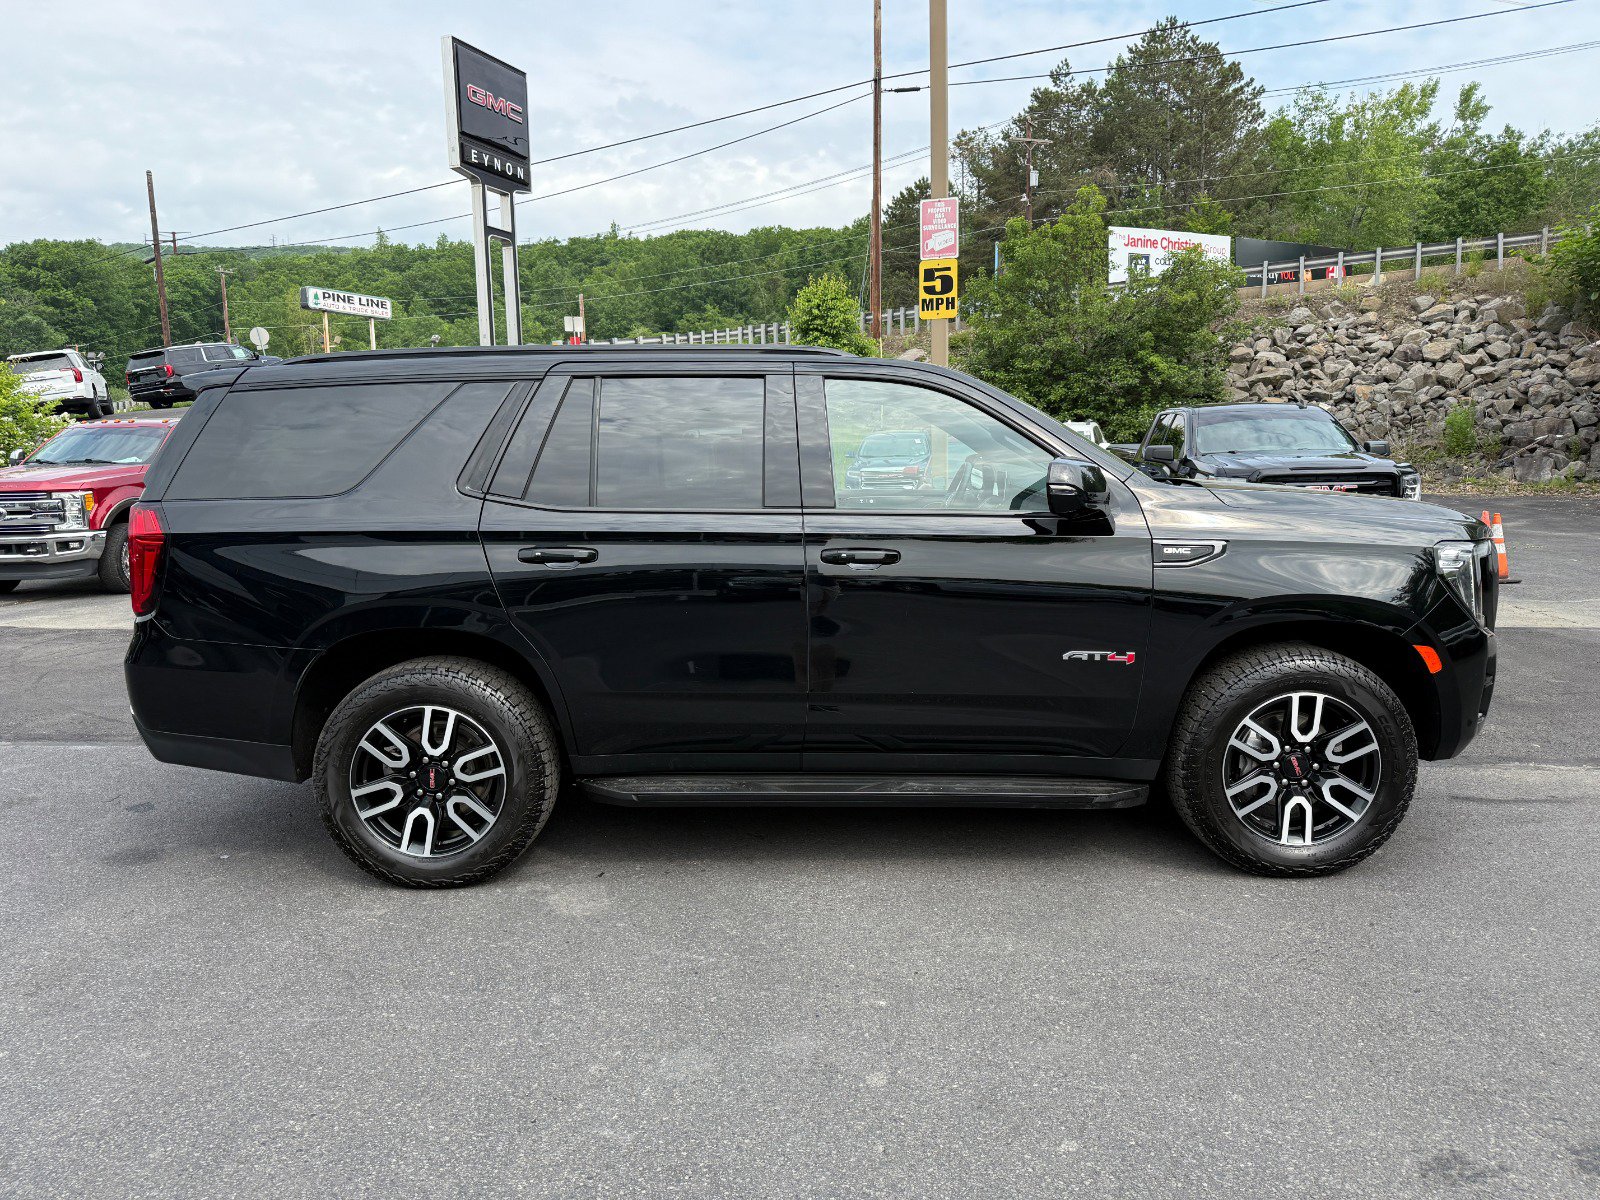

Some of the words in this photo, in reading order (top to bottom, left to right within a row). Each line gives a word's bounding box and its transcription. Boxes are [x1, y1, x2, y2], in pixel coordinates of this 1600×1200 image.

[467, 84, 523, 124] GMC
[471, 150, 524, 180] EYNON
[1114, 232, 1126, 240] The
[1124, 234, 1159, 249] Janine
[1204, 243, 1226, 256] Group
[923, 267, 954, 296] 5
[322, 291, 355, 305] PINE
[358, 297, 388, 309] LINE
[921, 297, 956, 311] MPH
[349, 306, 369, 314] TRUCK
[370, 308, 389, 316] SALES
[1063, 650, 1135, 665] AT4
[1291, 756, 1303, 777] GMC
